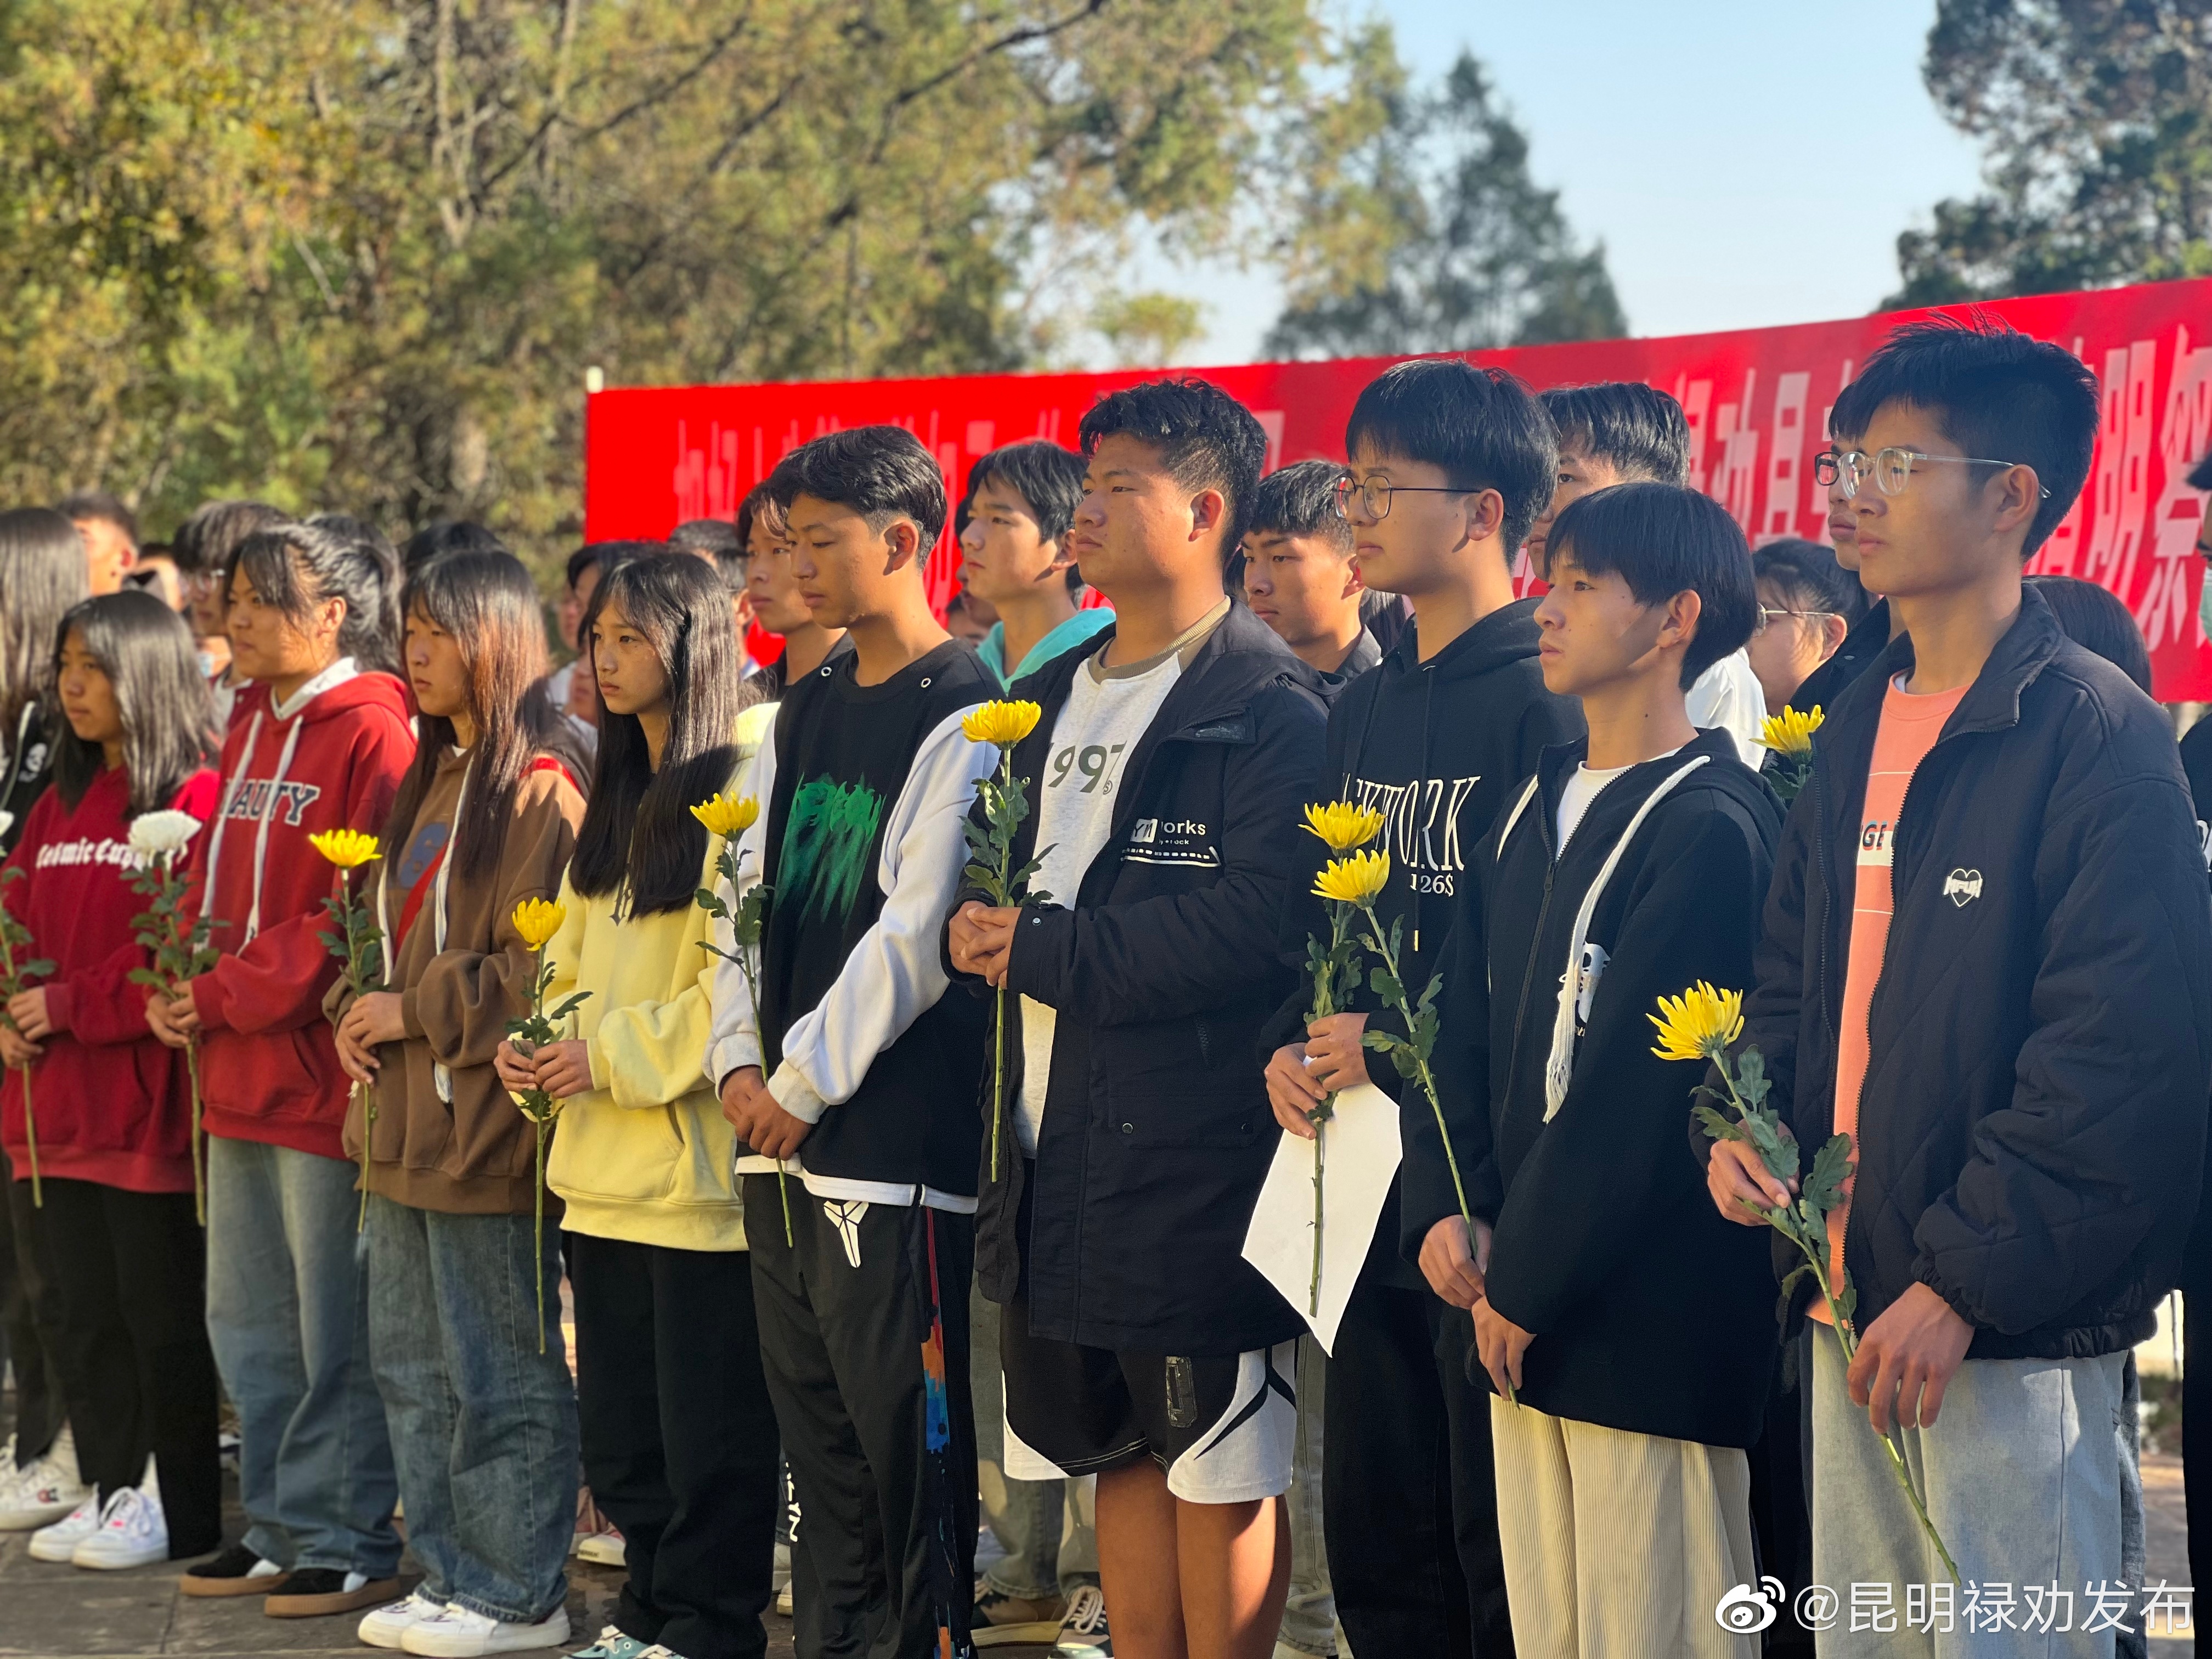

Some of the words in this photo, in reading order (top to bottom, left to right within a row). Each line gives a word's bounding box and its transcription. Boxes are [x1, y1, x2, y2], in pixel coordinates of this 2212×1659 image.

[1048, 741, 1127, 793] 997
[219, 778, 321, 827] AUTY
[1161, 820, 1206, 836] orks
